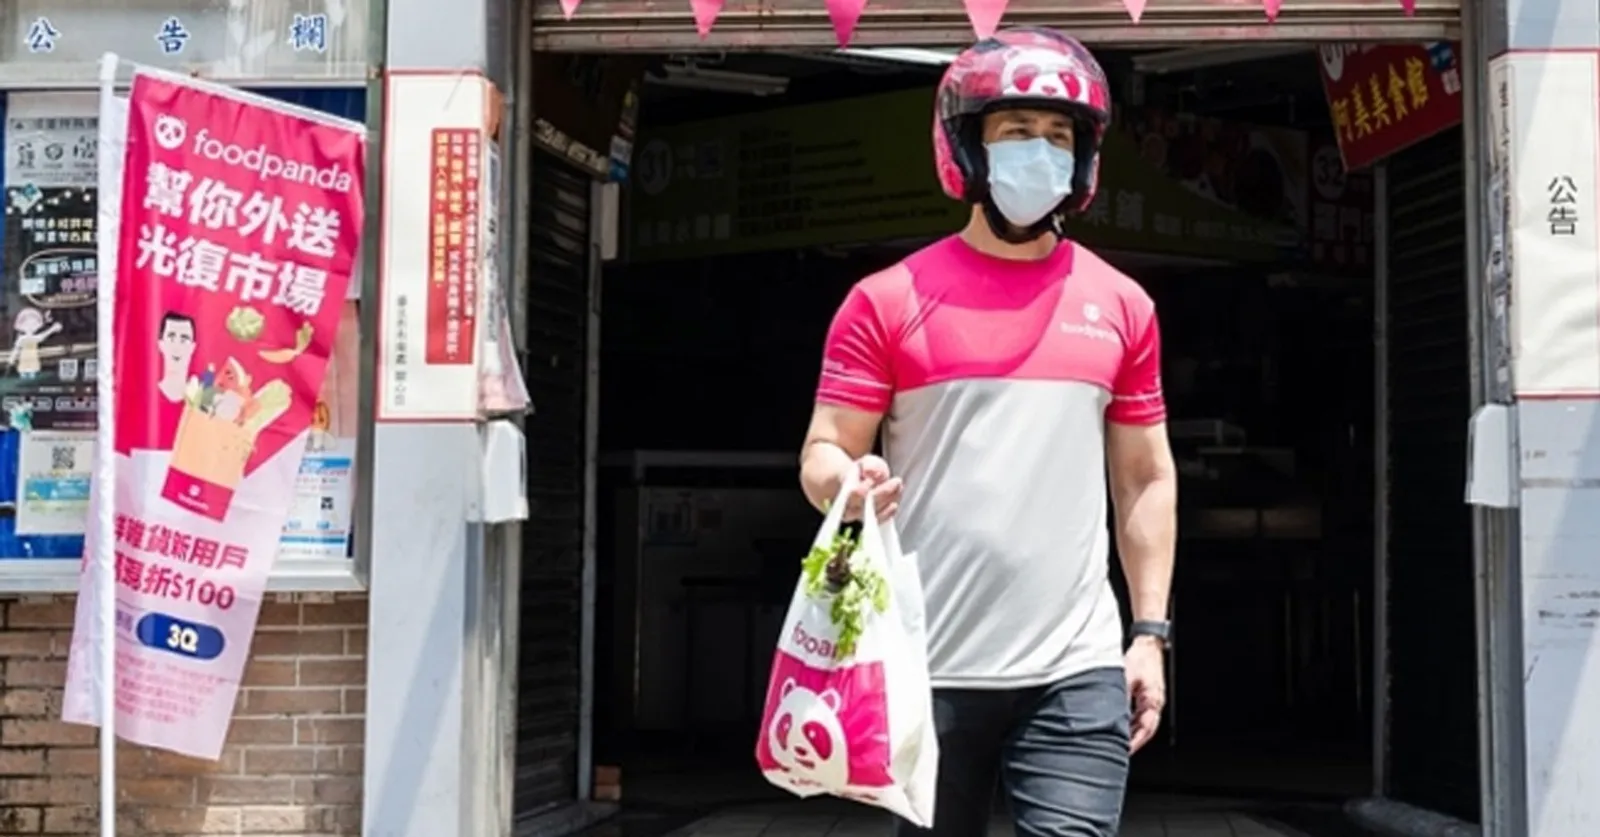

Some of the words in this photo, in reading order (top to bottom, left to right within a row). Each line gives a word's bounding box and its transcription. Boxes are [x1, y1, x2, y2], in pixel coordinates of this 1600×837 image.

[193, 129, 351, 193] foodpanda
[144, 162, 341, 258] 幫你外送
[1547, 175, 1578, 236] 公告
[135, 225, 328, 316] 光復市場
[167, 624, 199, 652] 3Q
